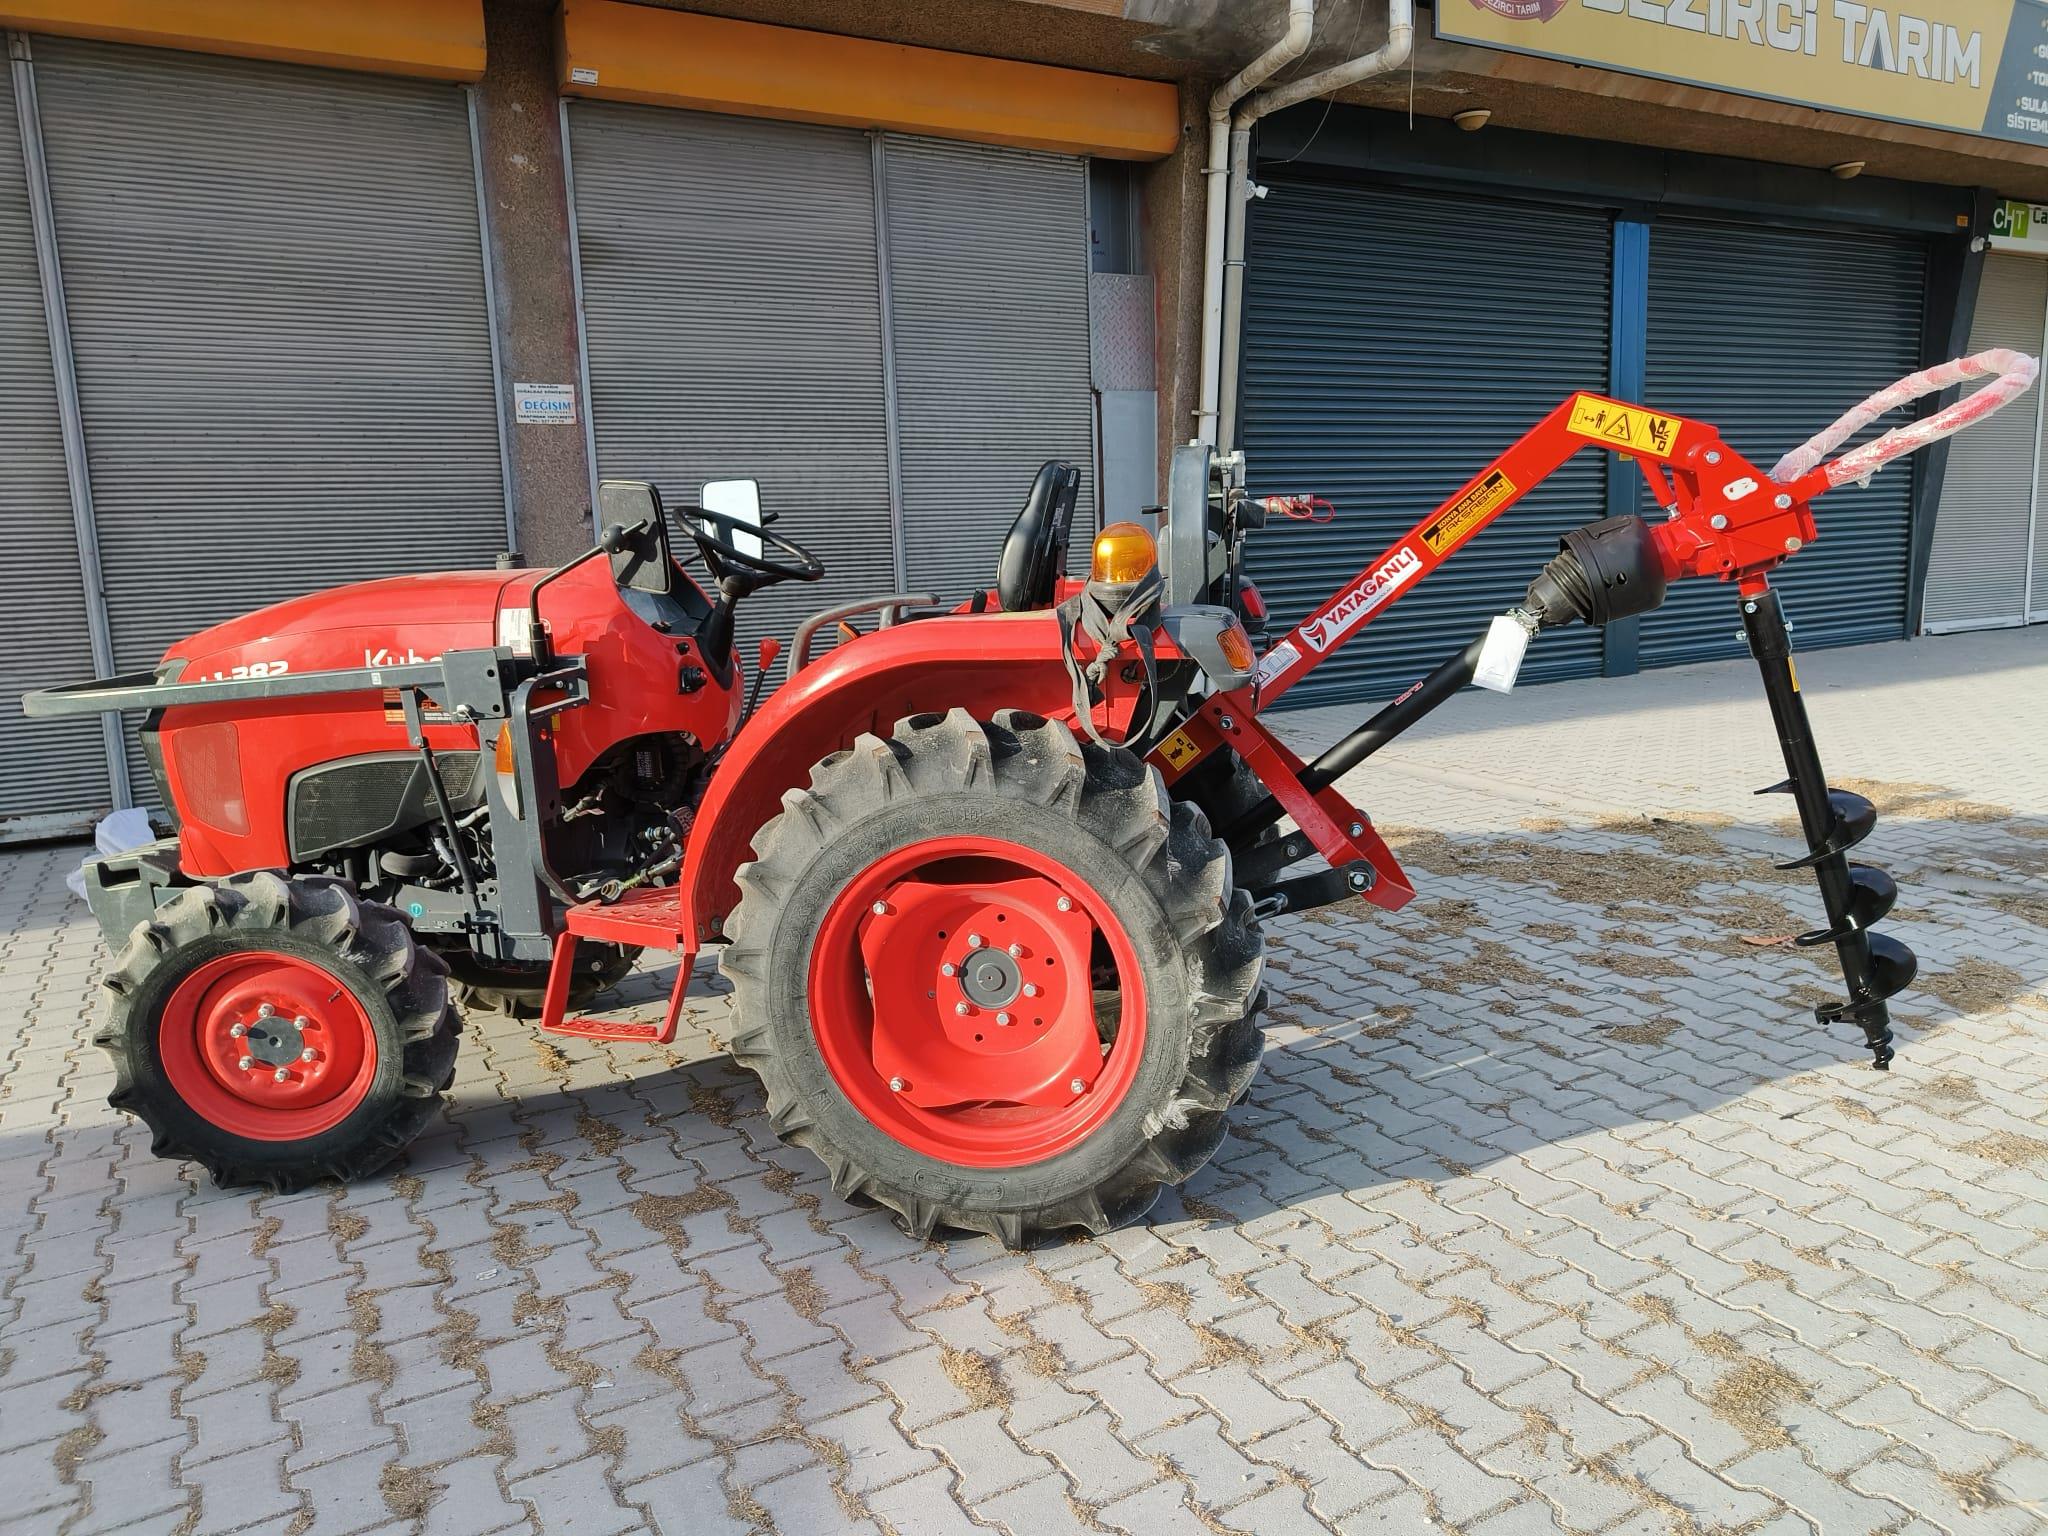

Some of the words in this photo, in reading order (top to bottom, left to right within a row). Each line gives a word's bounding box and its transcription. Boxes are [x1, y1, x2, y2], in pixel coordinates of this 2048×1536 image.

[1516, 2, 1541, 15] TARIM
[1833, 0, 1981, 89] TARIM
[1993, 200, 2024, 238] CHT
[1437, 511, 1459, 530] KONYA
[1457, 499, 1472, 513] ANA
[1446, 482, 1504, 533] AKSABAN
